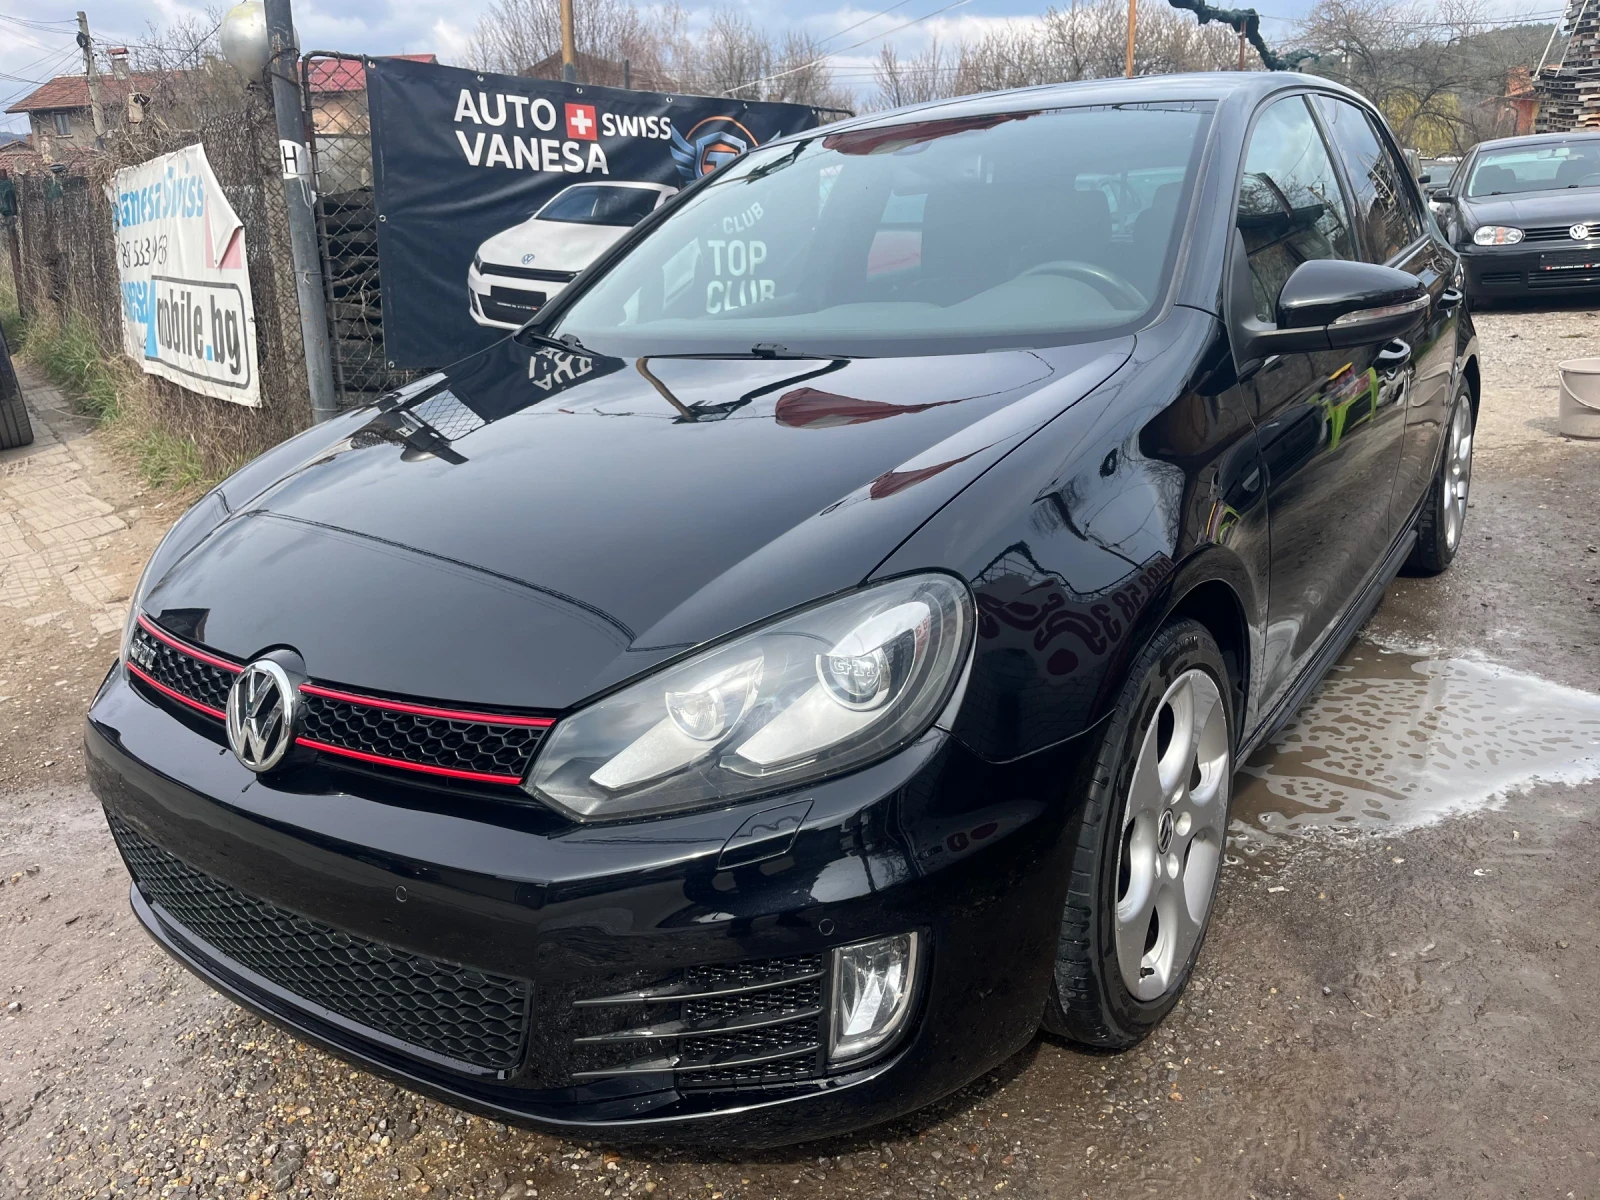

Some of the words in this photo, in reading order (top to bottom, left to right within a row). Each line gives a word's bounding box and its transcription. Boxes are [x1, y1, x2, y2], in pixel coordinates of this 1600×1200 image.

[453, 88, 557, 131] AUTO
[601, 112, 672, 140] SWISS
[455, 130, 609, 175] VANESA
[722, 201, 764, 234] CLUB
[707, 240, 767, 276] TOP
